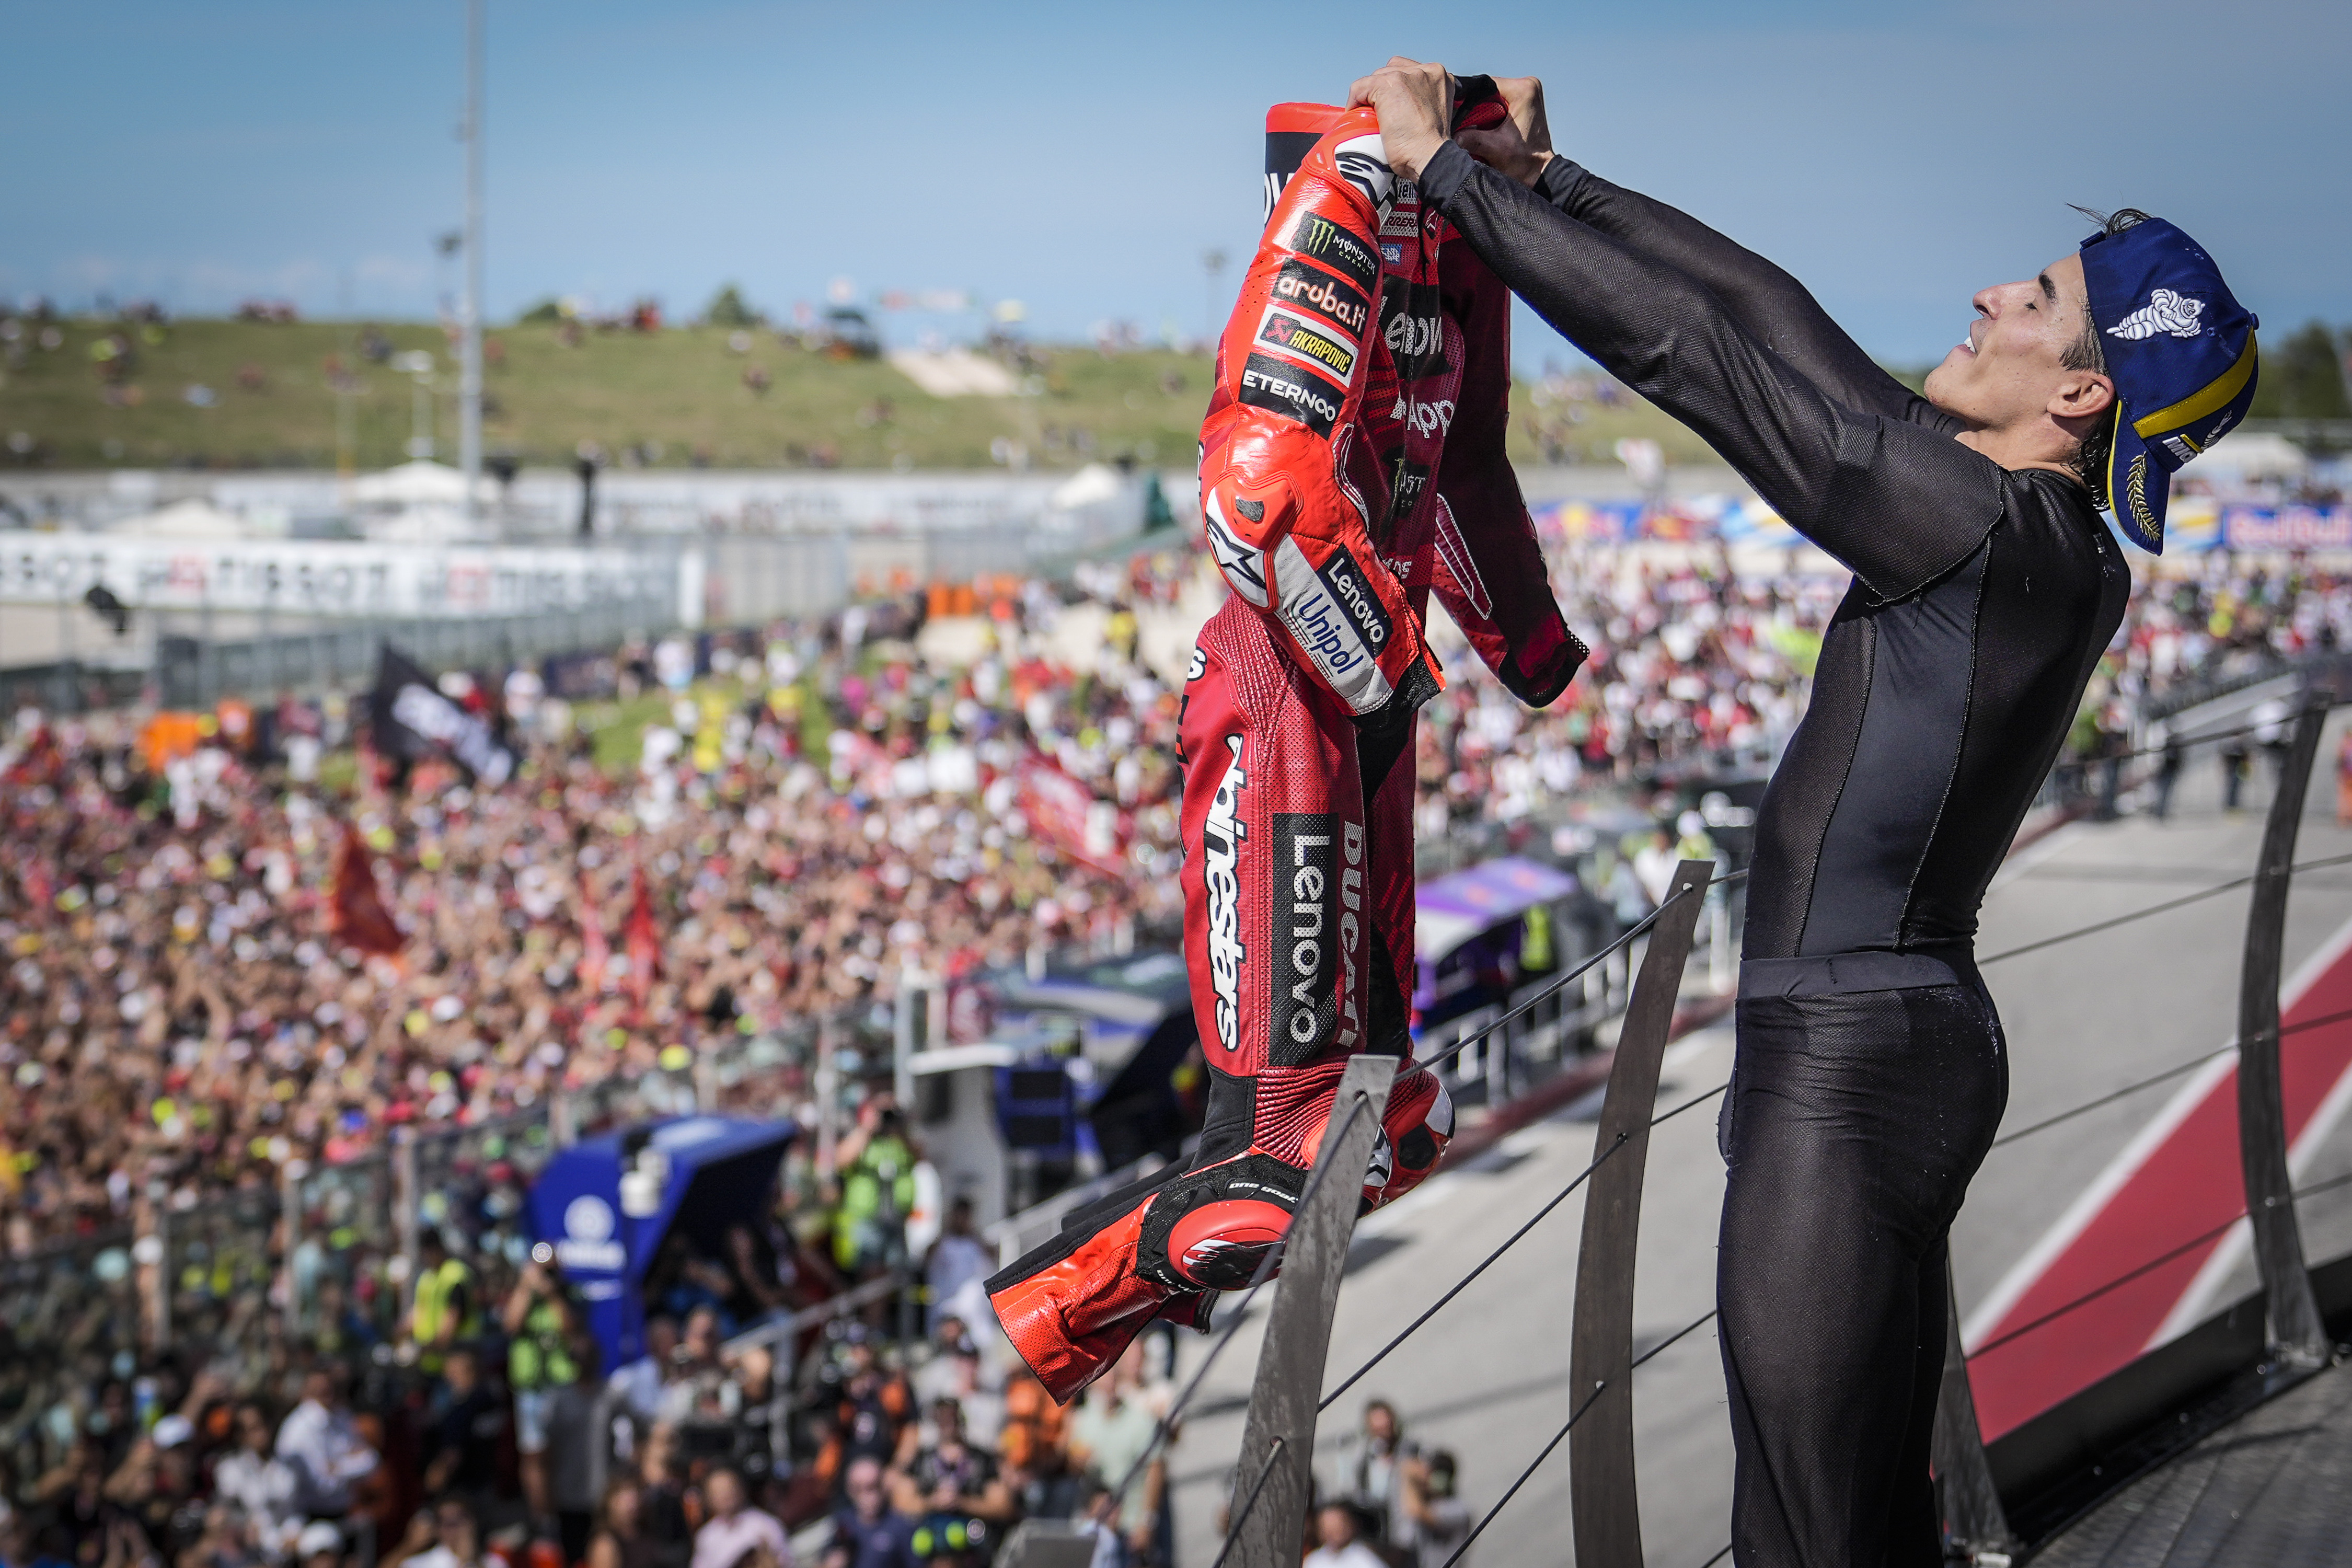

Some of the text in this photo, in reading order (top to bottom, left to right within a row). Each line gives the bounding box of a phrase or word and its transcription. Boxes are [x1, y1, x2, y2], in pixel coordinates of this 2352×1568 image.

[1278, 276, 1365, 332] aruba.it
[1288, 330, 1351, 373] AKRAPOVIČ
[1299, 593, 1364, 675] Unipol
[1328, 558, 1384, 643] Lenovo
[1290, 835, 1331, 1044] Lenovo
